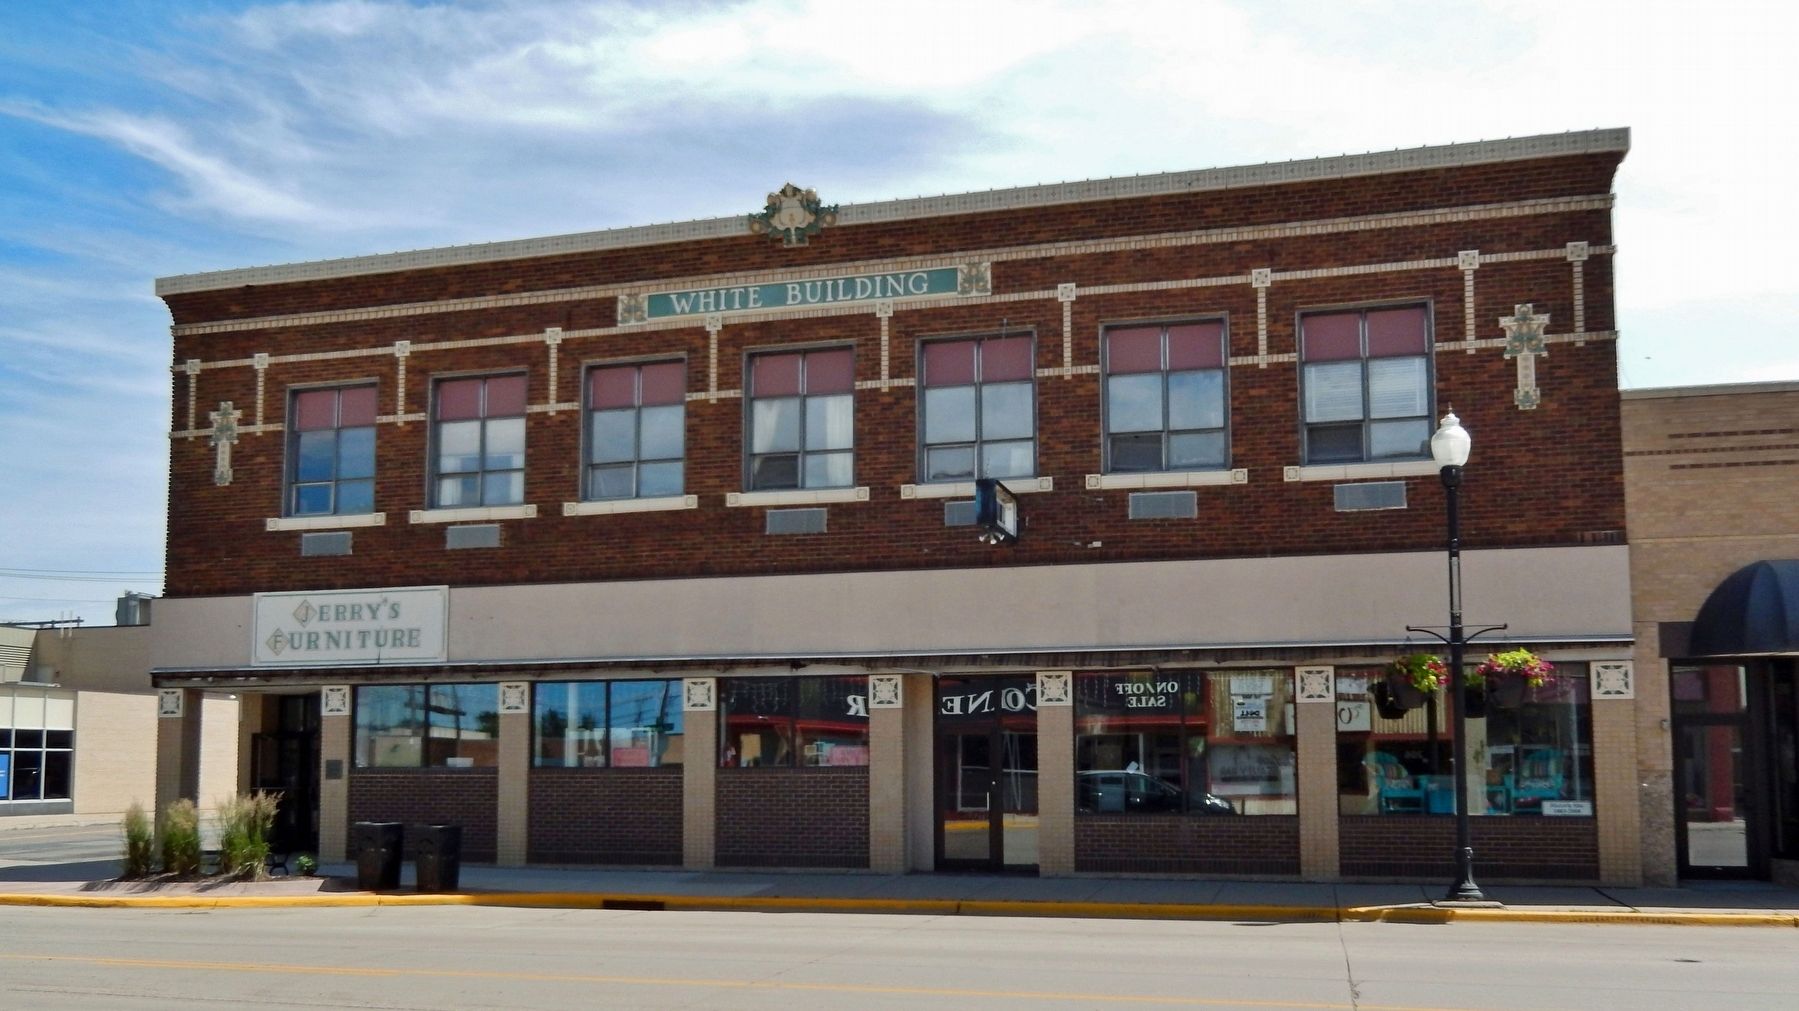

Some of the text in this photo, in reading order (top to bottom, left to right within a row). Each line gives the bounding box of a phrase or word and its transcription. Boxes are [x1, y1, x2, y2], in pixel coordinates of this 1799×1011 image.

[669, 273, 929, 315] WHITE BUILDING
[301, 597, 400, 622] JERRY'S
[273, 628, 421, 650] FURNITURE
